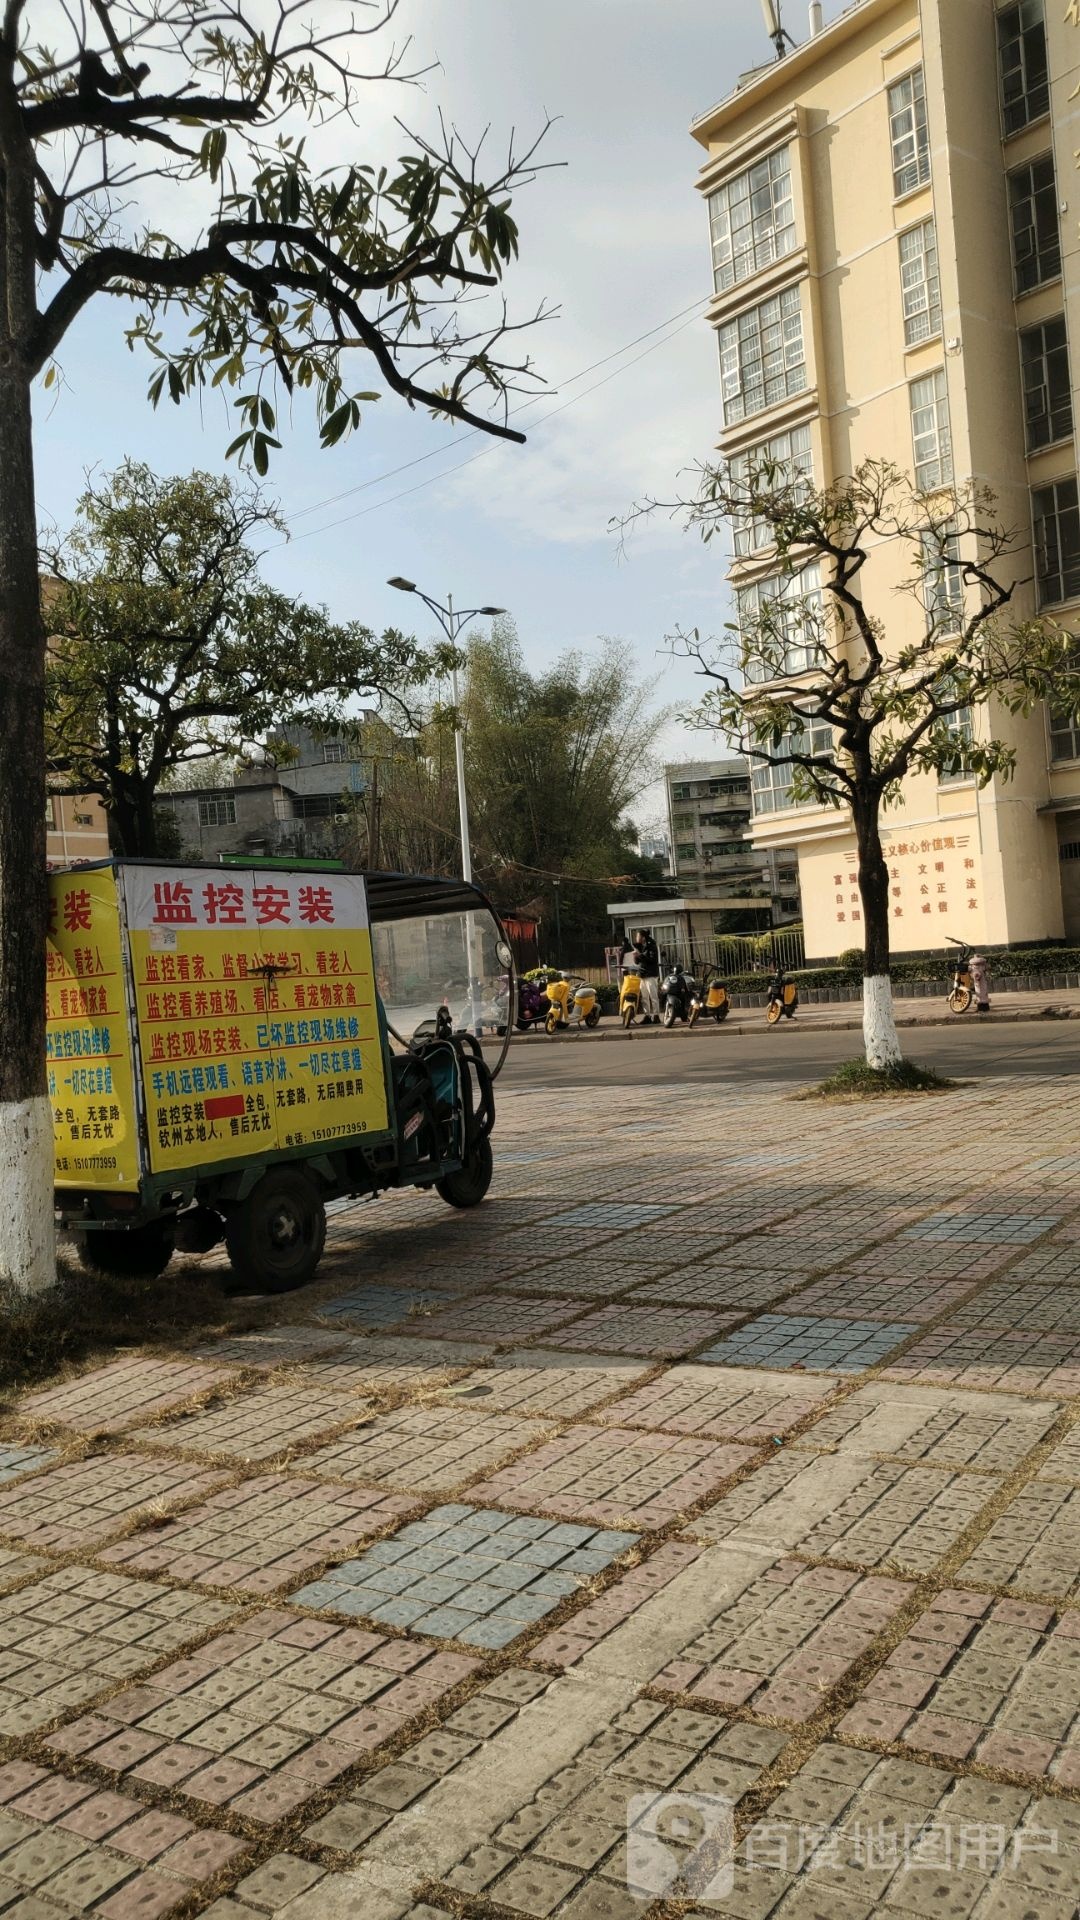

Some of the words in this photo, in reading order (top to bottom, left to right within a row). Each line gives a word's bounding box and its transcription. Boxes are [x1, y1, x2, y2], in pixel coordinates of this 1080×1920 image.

[917, 861, 944, 875] 文明
[963, 857, 975, 870] 和
[920, 883, 947, 895] 公正
[966, 878, 977, 890] 法
[152, 881, 336, 925] 监控安装
[157, 1102, 206, 1128] 监控安装
